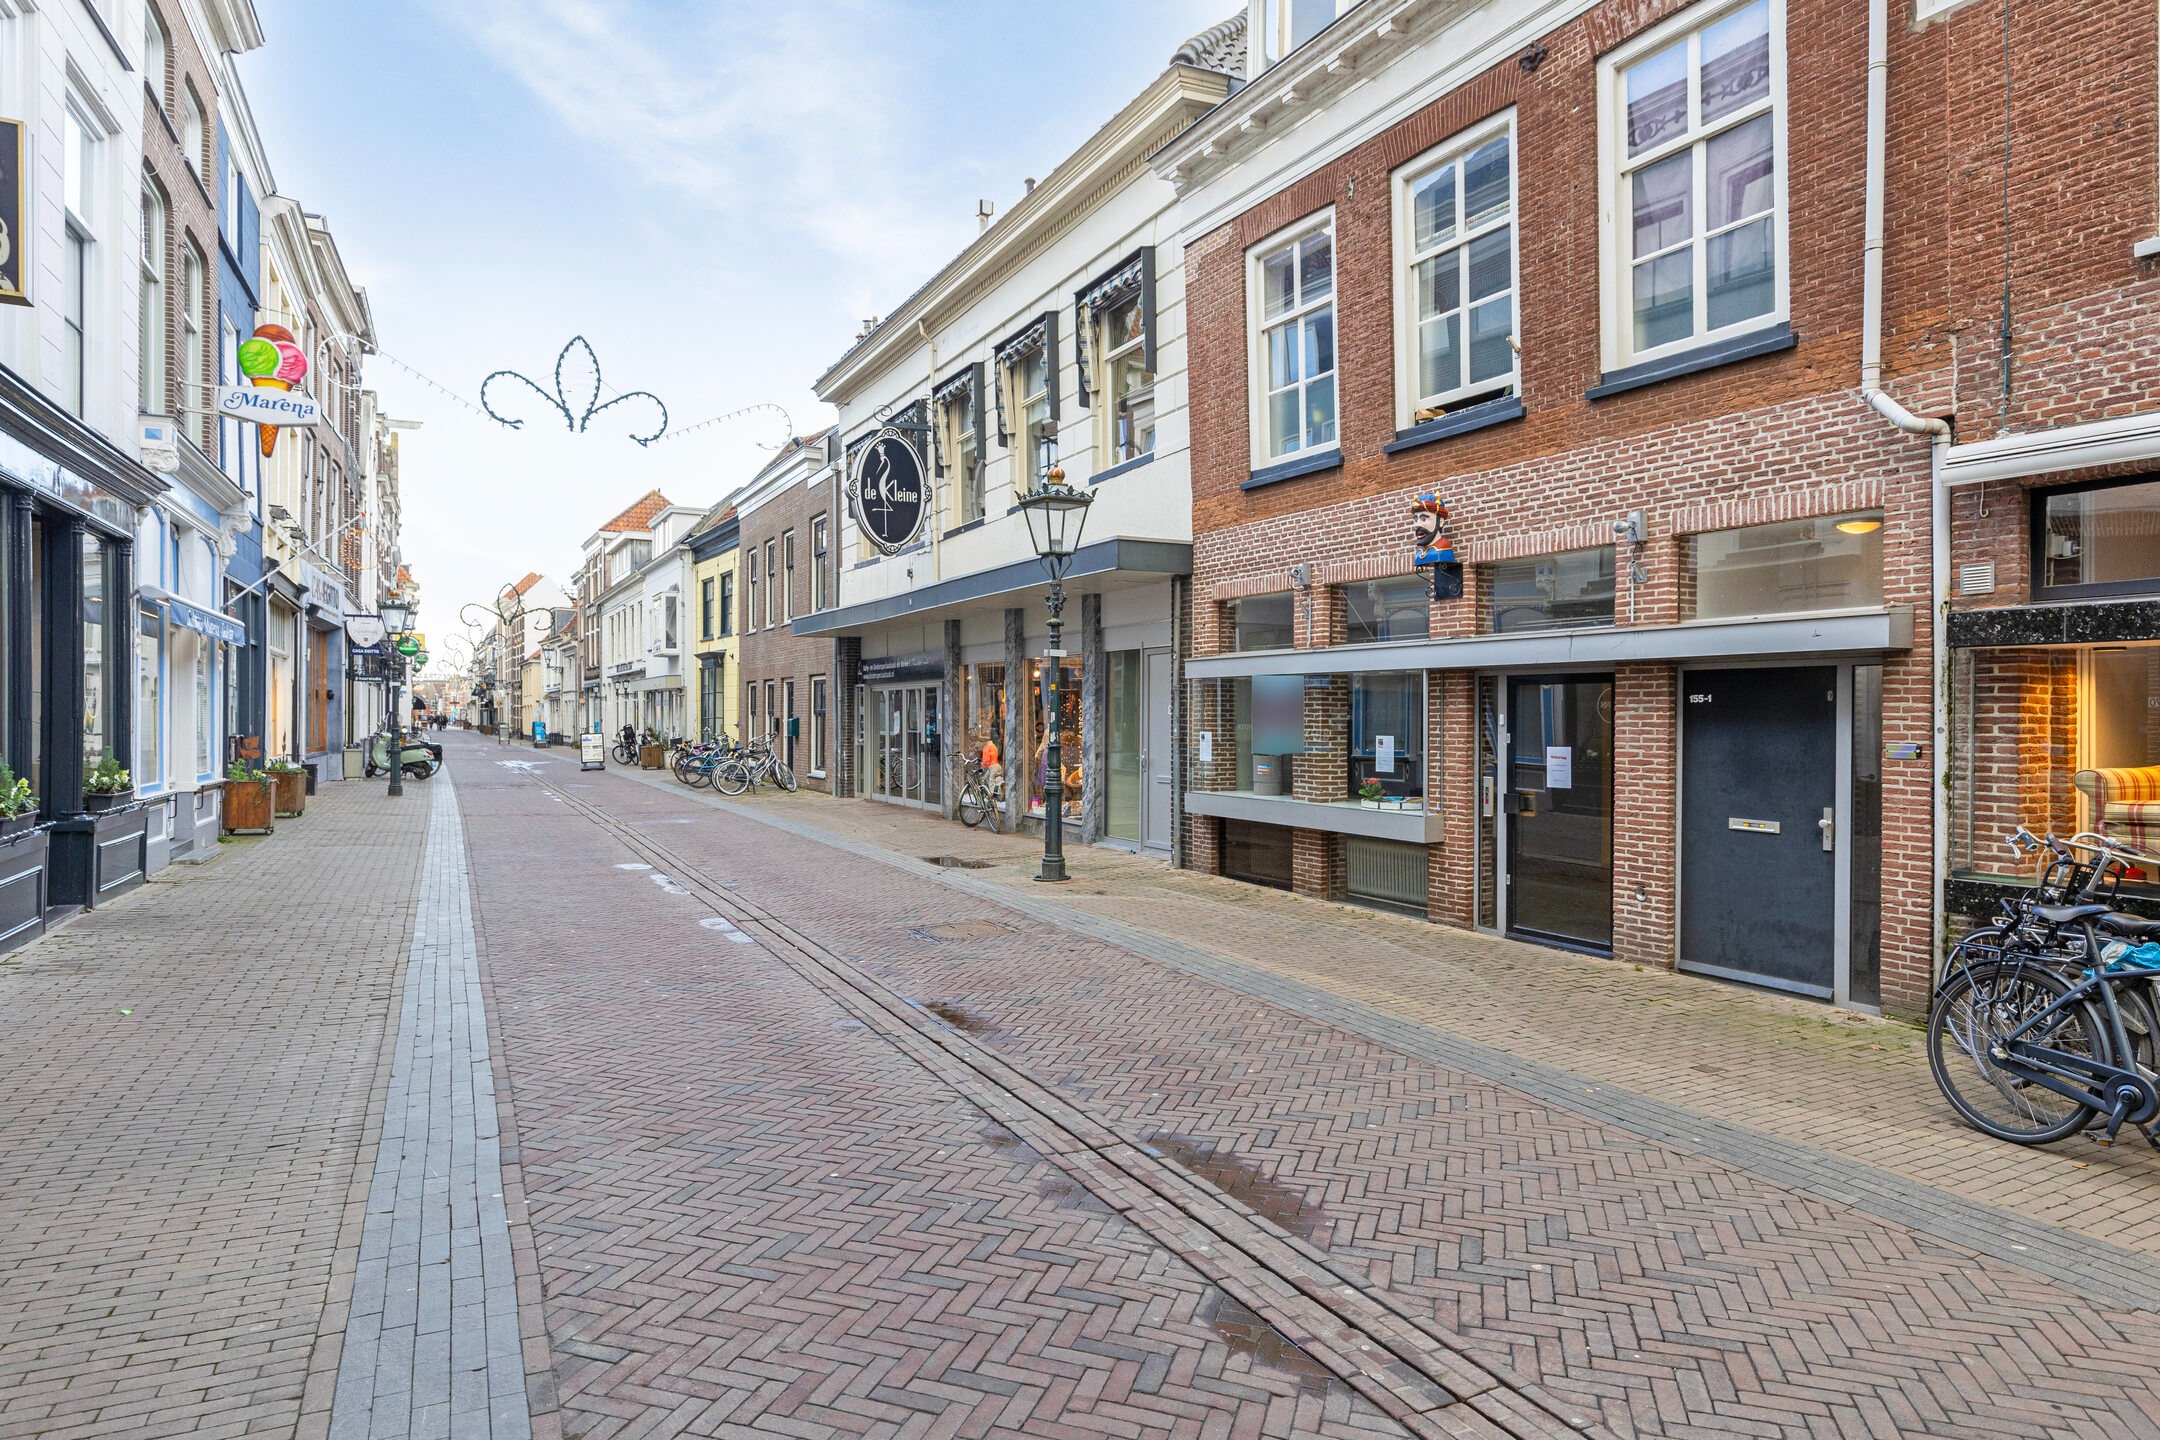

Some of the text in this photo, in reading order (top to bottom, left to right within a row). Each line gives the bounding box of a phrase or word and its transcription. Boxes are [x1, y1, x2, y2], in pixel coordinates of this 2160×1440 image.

[224, 392, 314, 419] Marena
[864, 477, 918, 502] de Kleine
[1689, 694, 1712, 703] 155-1
